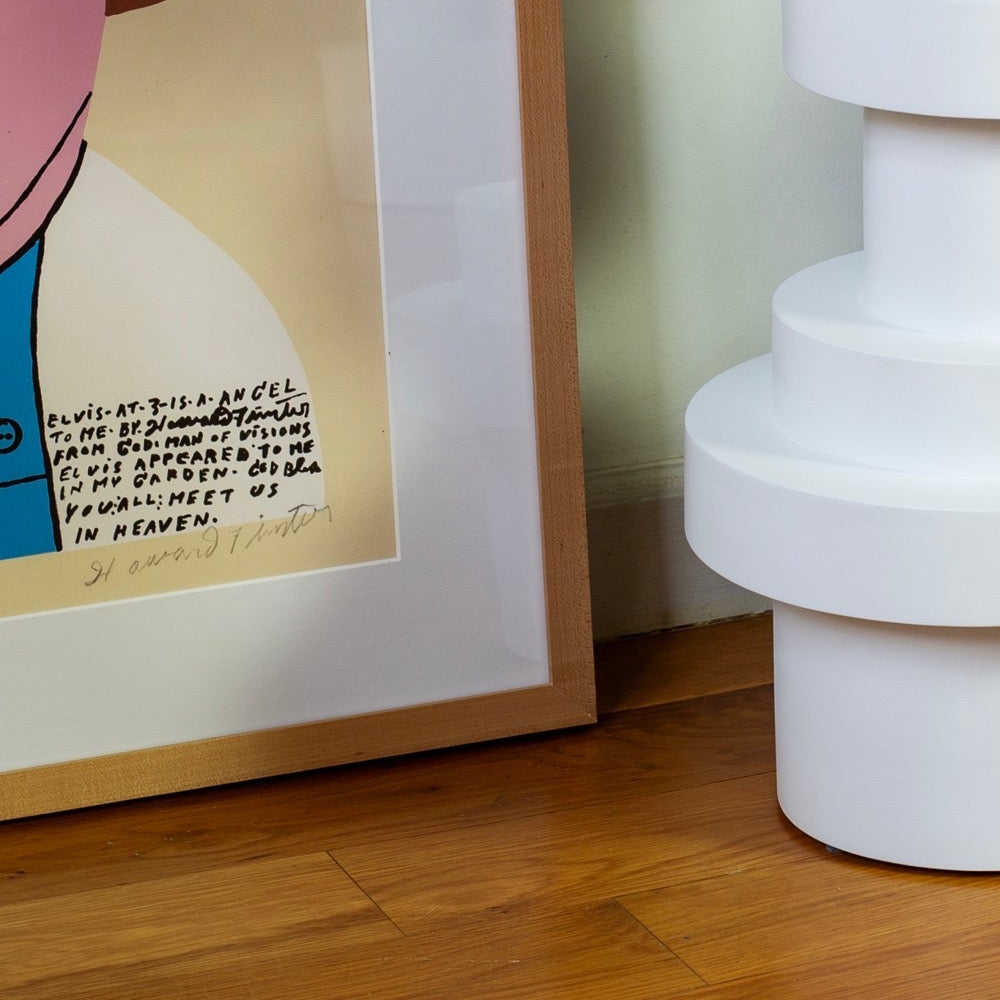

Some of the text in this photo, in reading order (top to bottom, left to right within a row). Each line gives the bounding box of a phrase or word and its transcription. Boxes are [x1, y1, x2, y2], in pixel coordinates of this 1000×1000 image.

[219, 378, 296, 407] ANGEL
[50, 430, 72, 443] TO
[53, 443, 105, 466] FROM
[164, 431, 203, 449] MAN
[210, 430, 231, 443] OF
[134, 446, 250, 472] APPEARED
[289, 440, 315, 455] ME
[60, 481, 83, 500] IN
[92, 476, 122, 493] MY
[248, 459, 278, 477] GOD
[168, 488, 234, 506] MEET
[250, 482, 279, 498] US
[75, 527, 98, 544] IN
